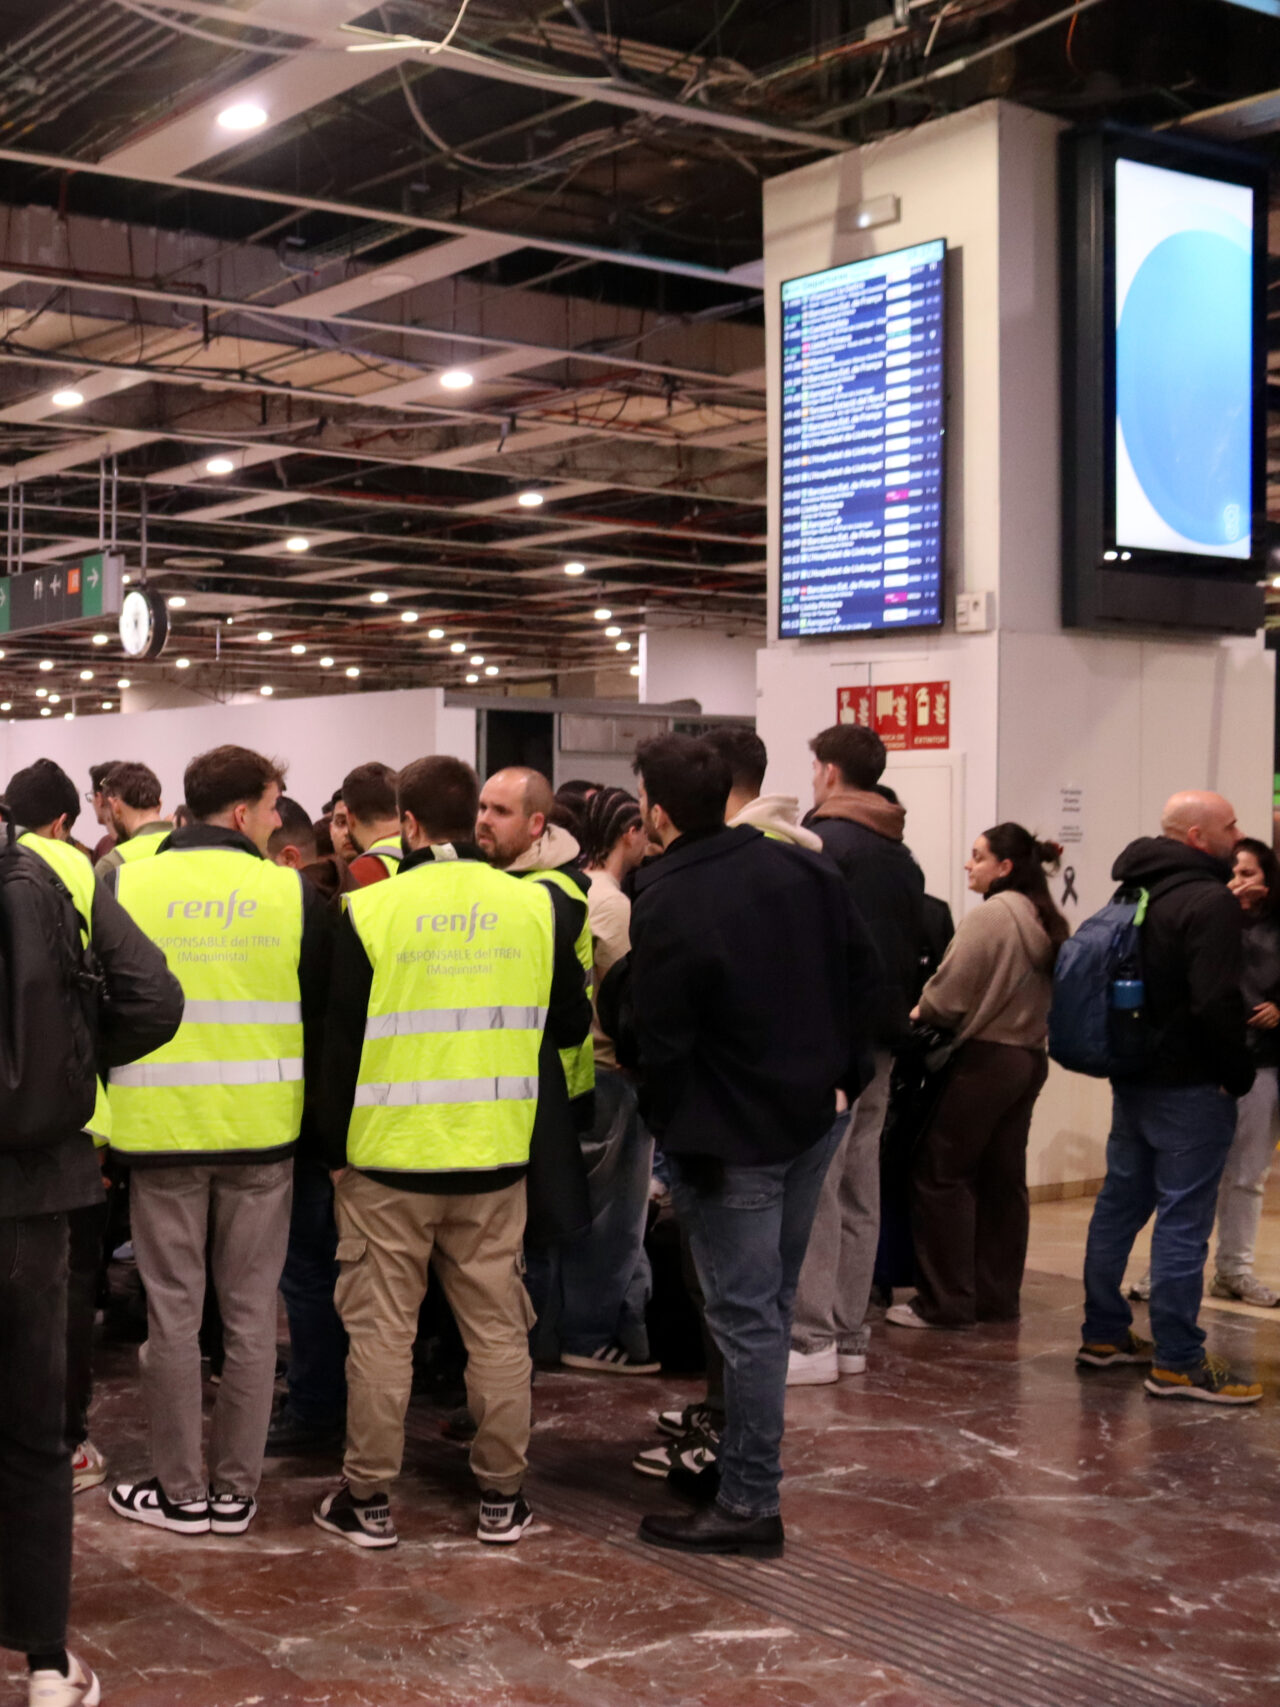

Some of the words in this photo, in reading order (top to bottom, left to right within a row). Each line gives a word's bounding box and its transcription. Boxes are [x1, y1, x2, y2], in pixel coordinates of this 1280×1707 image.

[166, 888, 258, 931] renfe
[416, 902, 499, 943] renfe
[231, 936, 249, 948] del
[252, 935, 281, 948] TREN
[177, 951, 249, 964] (Maquinista)
[396, 948, 471, 965] RESPONSABLE
[493, 946, 521, 960] TREN
[426, 963, 493, 977] (Maquinista)
[481, 1505, 508, 1518] PUMA
